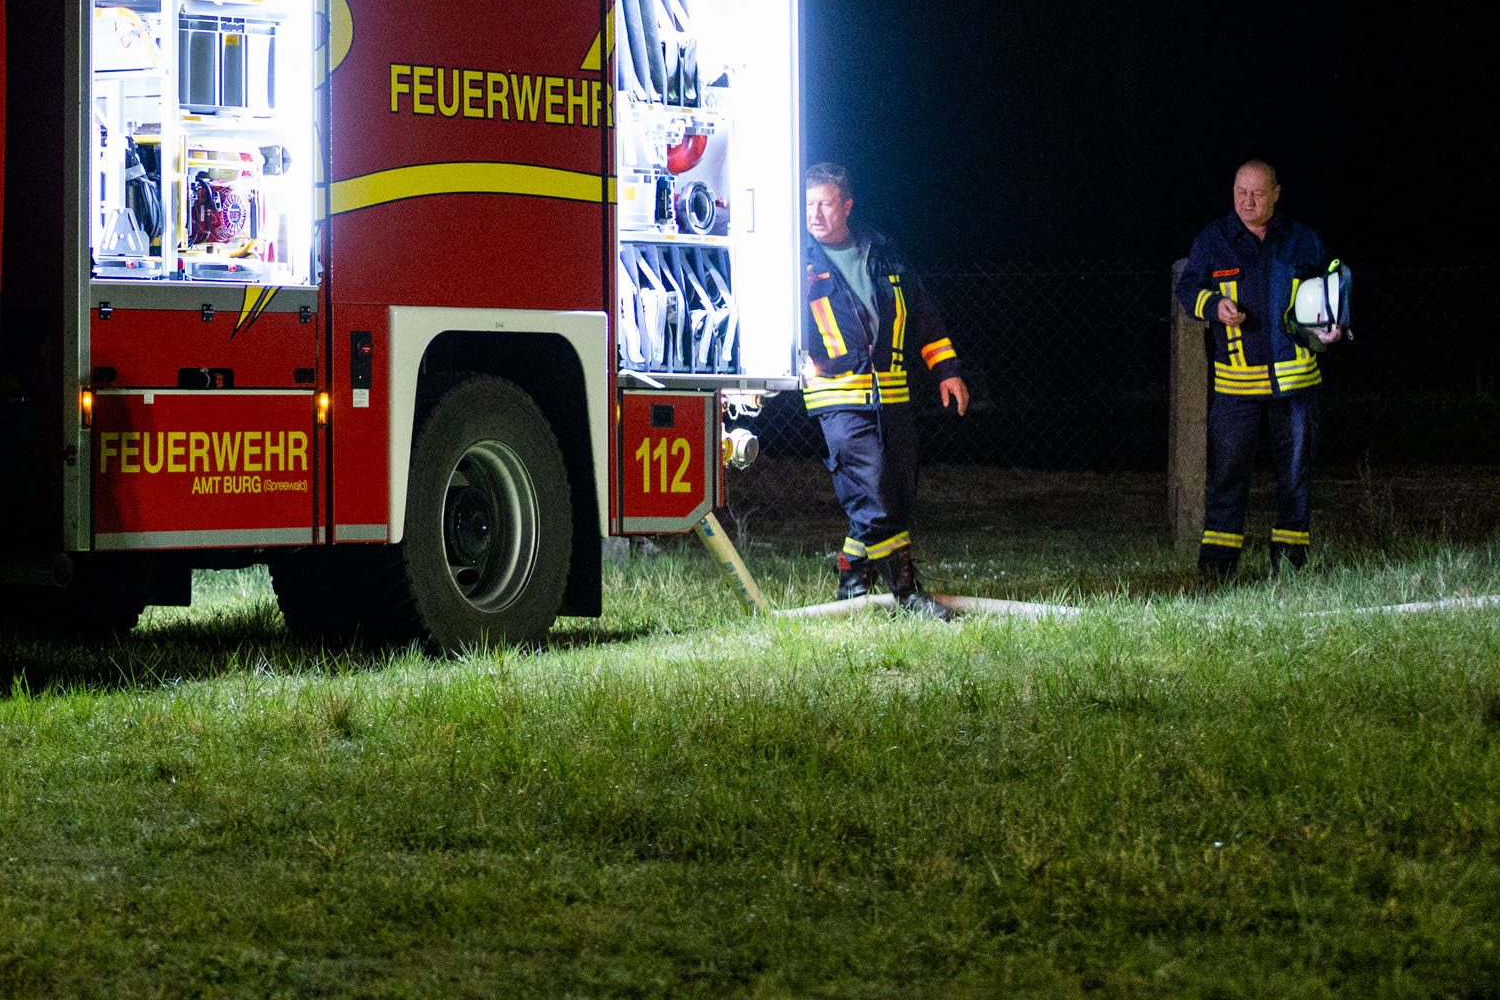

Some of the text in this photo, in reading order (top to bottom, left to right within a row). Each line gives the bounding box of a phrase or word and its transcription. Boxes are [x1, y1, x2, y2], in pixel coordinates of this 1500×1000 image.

[389, 62, 615, 129] FEUERWEHR
[100, 431, 309, 474] FEUERWEHR
[635, 437, 691, 493] 112
[192, 475, 308, 494] AMT BURG (Spreewald)
